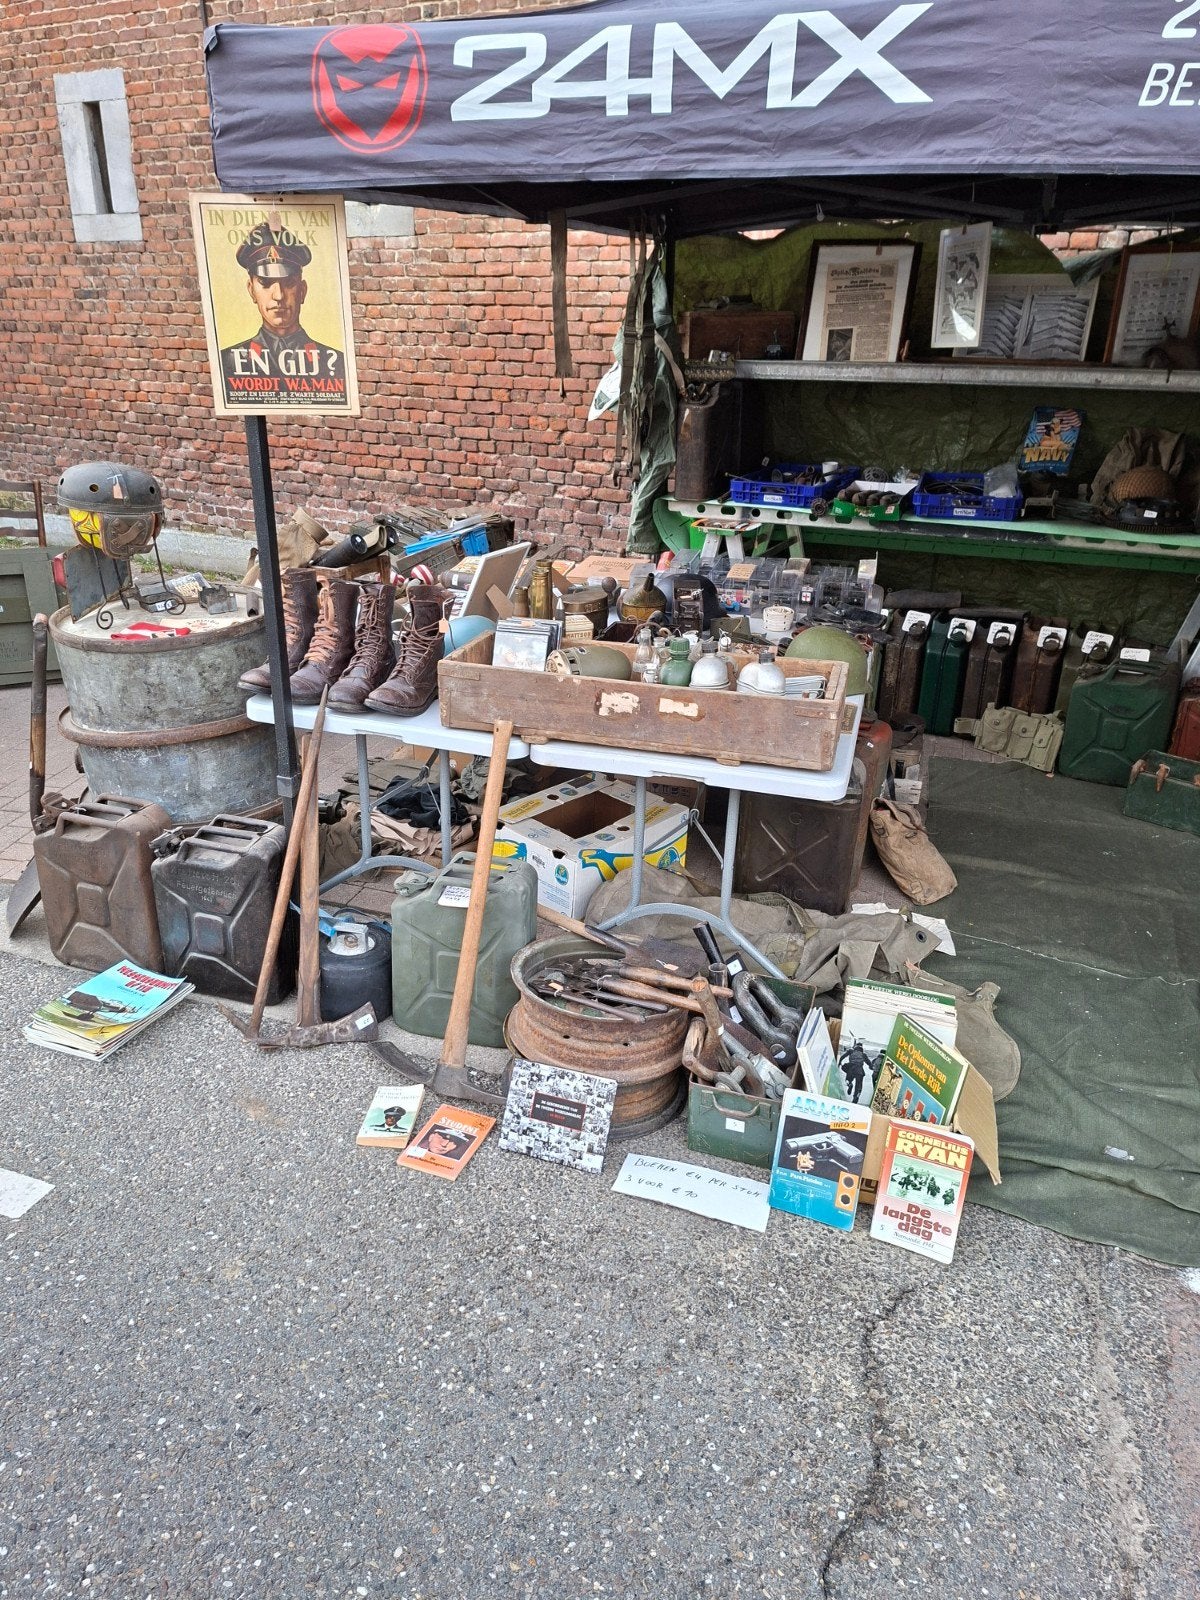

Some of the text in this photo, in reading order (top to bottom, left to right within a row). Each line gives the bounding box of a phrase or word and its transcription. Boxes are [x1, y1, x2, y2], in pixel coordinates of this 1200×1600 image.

[1161, 0, 1200, 38] 2
[451, 3, 934, 122] 24MX
[1138, 63, 1200, 106] BE
[208, 209, 330, 227] IN DIENT VAN
[227, 229, 318, 246] ONS VOLK
[231, 349, 270, 375] EN
[278, 349, 320, 376] GIJ
[228, 377, 280, 391] WORDT
[1023, 448, 1070, 463] NAVY
[871, 986, 894, 994] TWEEDE
[894, 989, 940, 1003] WERELDOORLOG
[898, 1034, 947, 1084] De Opkomst van
[923, 1036, 952, 1064] WERELDOORLOG
[896, 1048, 942, 1095] Het Derde Rijk
[439, 1116, 479, 1134] STUDENT
[895, 1138, 968, 1169] RYAN
[898, 1131, 968, 1156] CORNELIUS
[624, 1174, 632, 1182] 3
[638, 1177, 663, 1189] VOOR
[708, 1177, 727, 1187] PER
[883, 1205, 952, 1236] langste
[907, 1203, 931, 1219] De
[897, 1222, 933, 1241] dag
